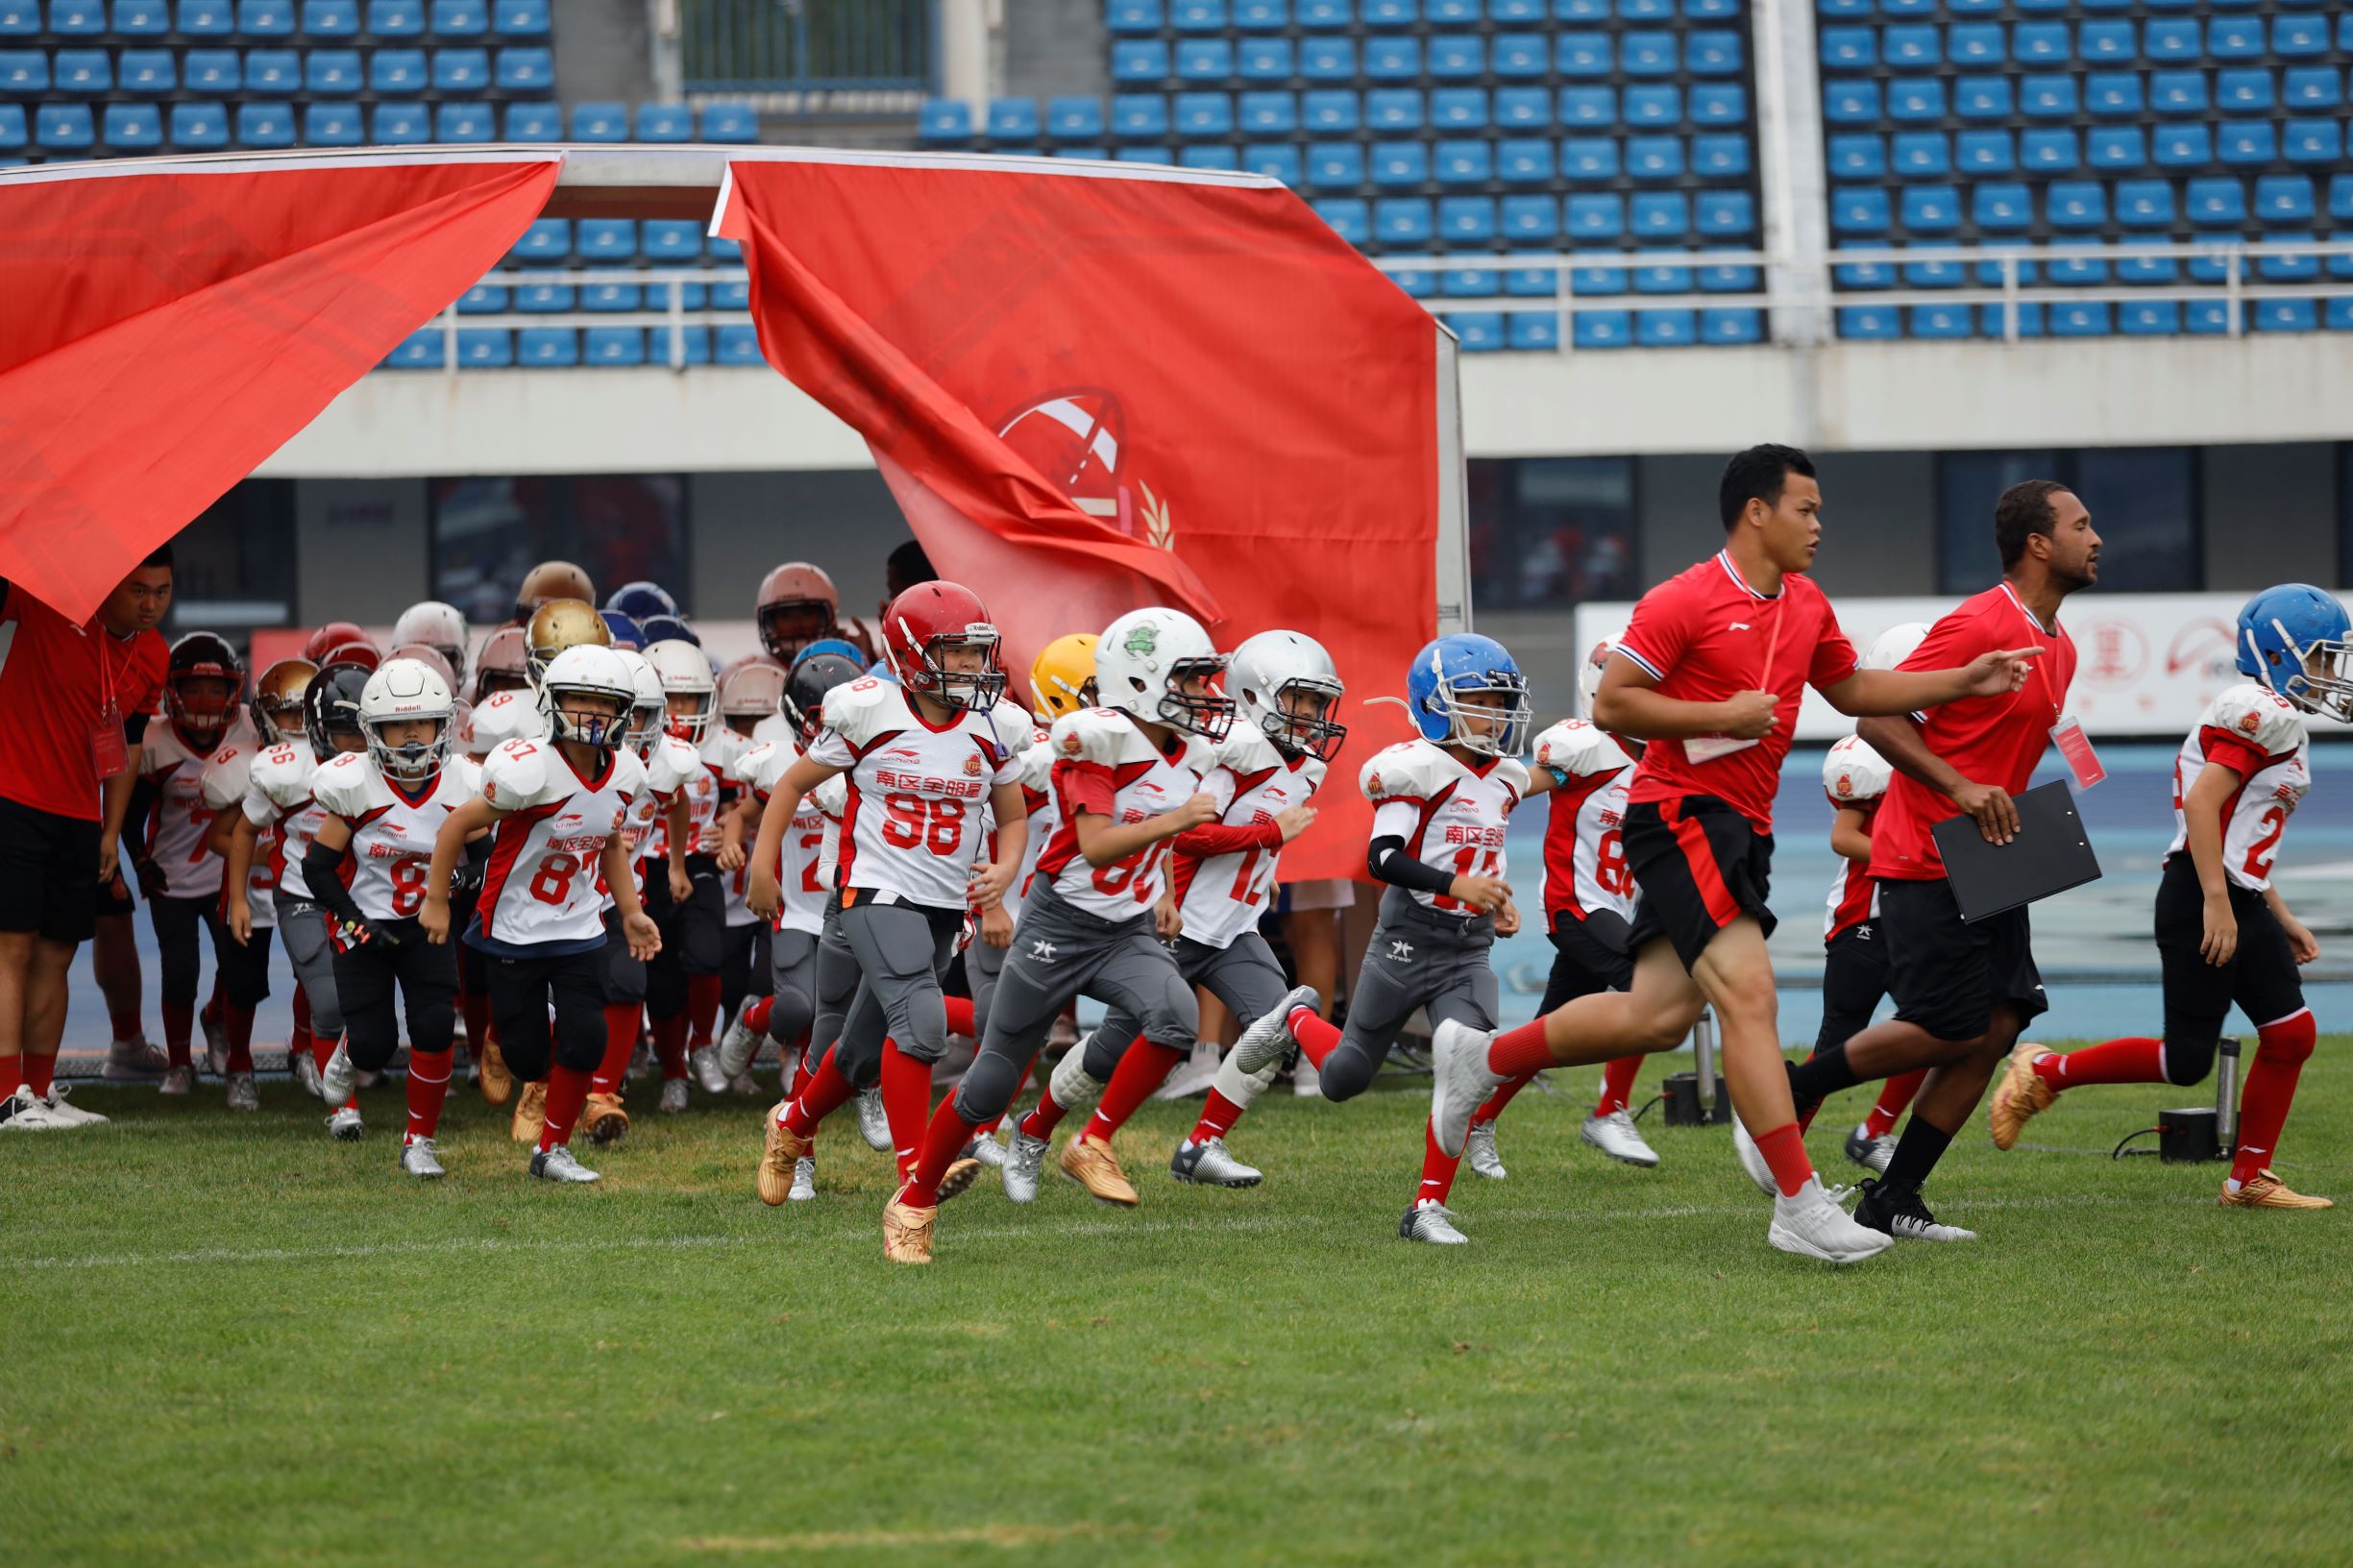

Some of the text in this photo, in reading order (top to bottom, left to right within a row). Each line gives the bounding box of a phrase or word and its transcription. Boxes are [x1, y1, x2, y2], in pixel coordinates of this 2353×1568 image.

[875, 770, 983, 798] 南区全明星
[881, 792, 966, 856] 98
